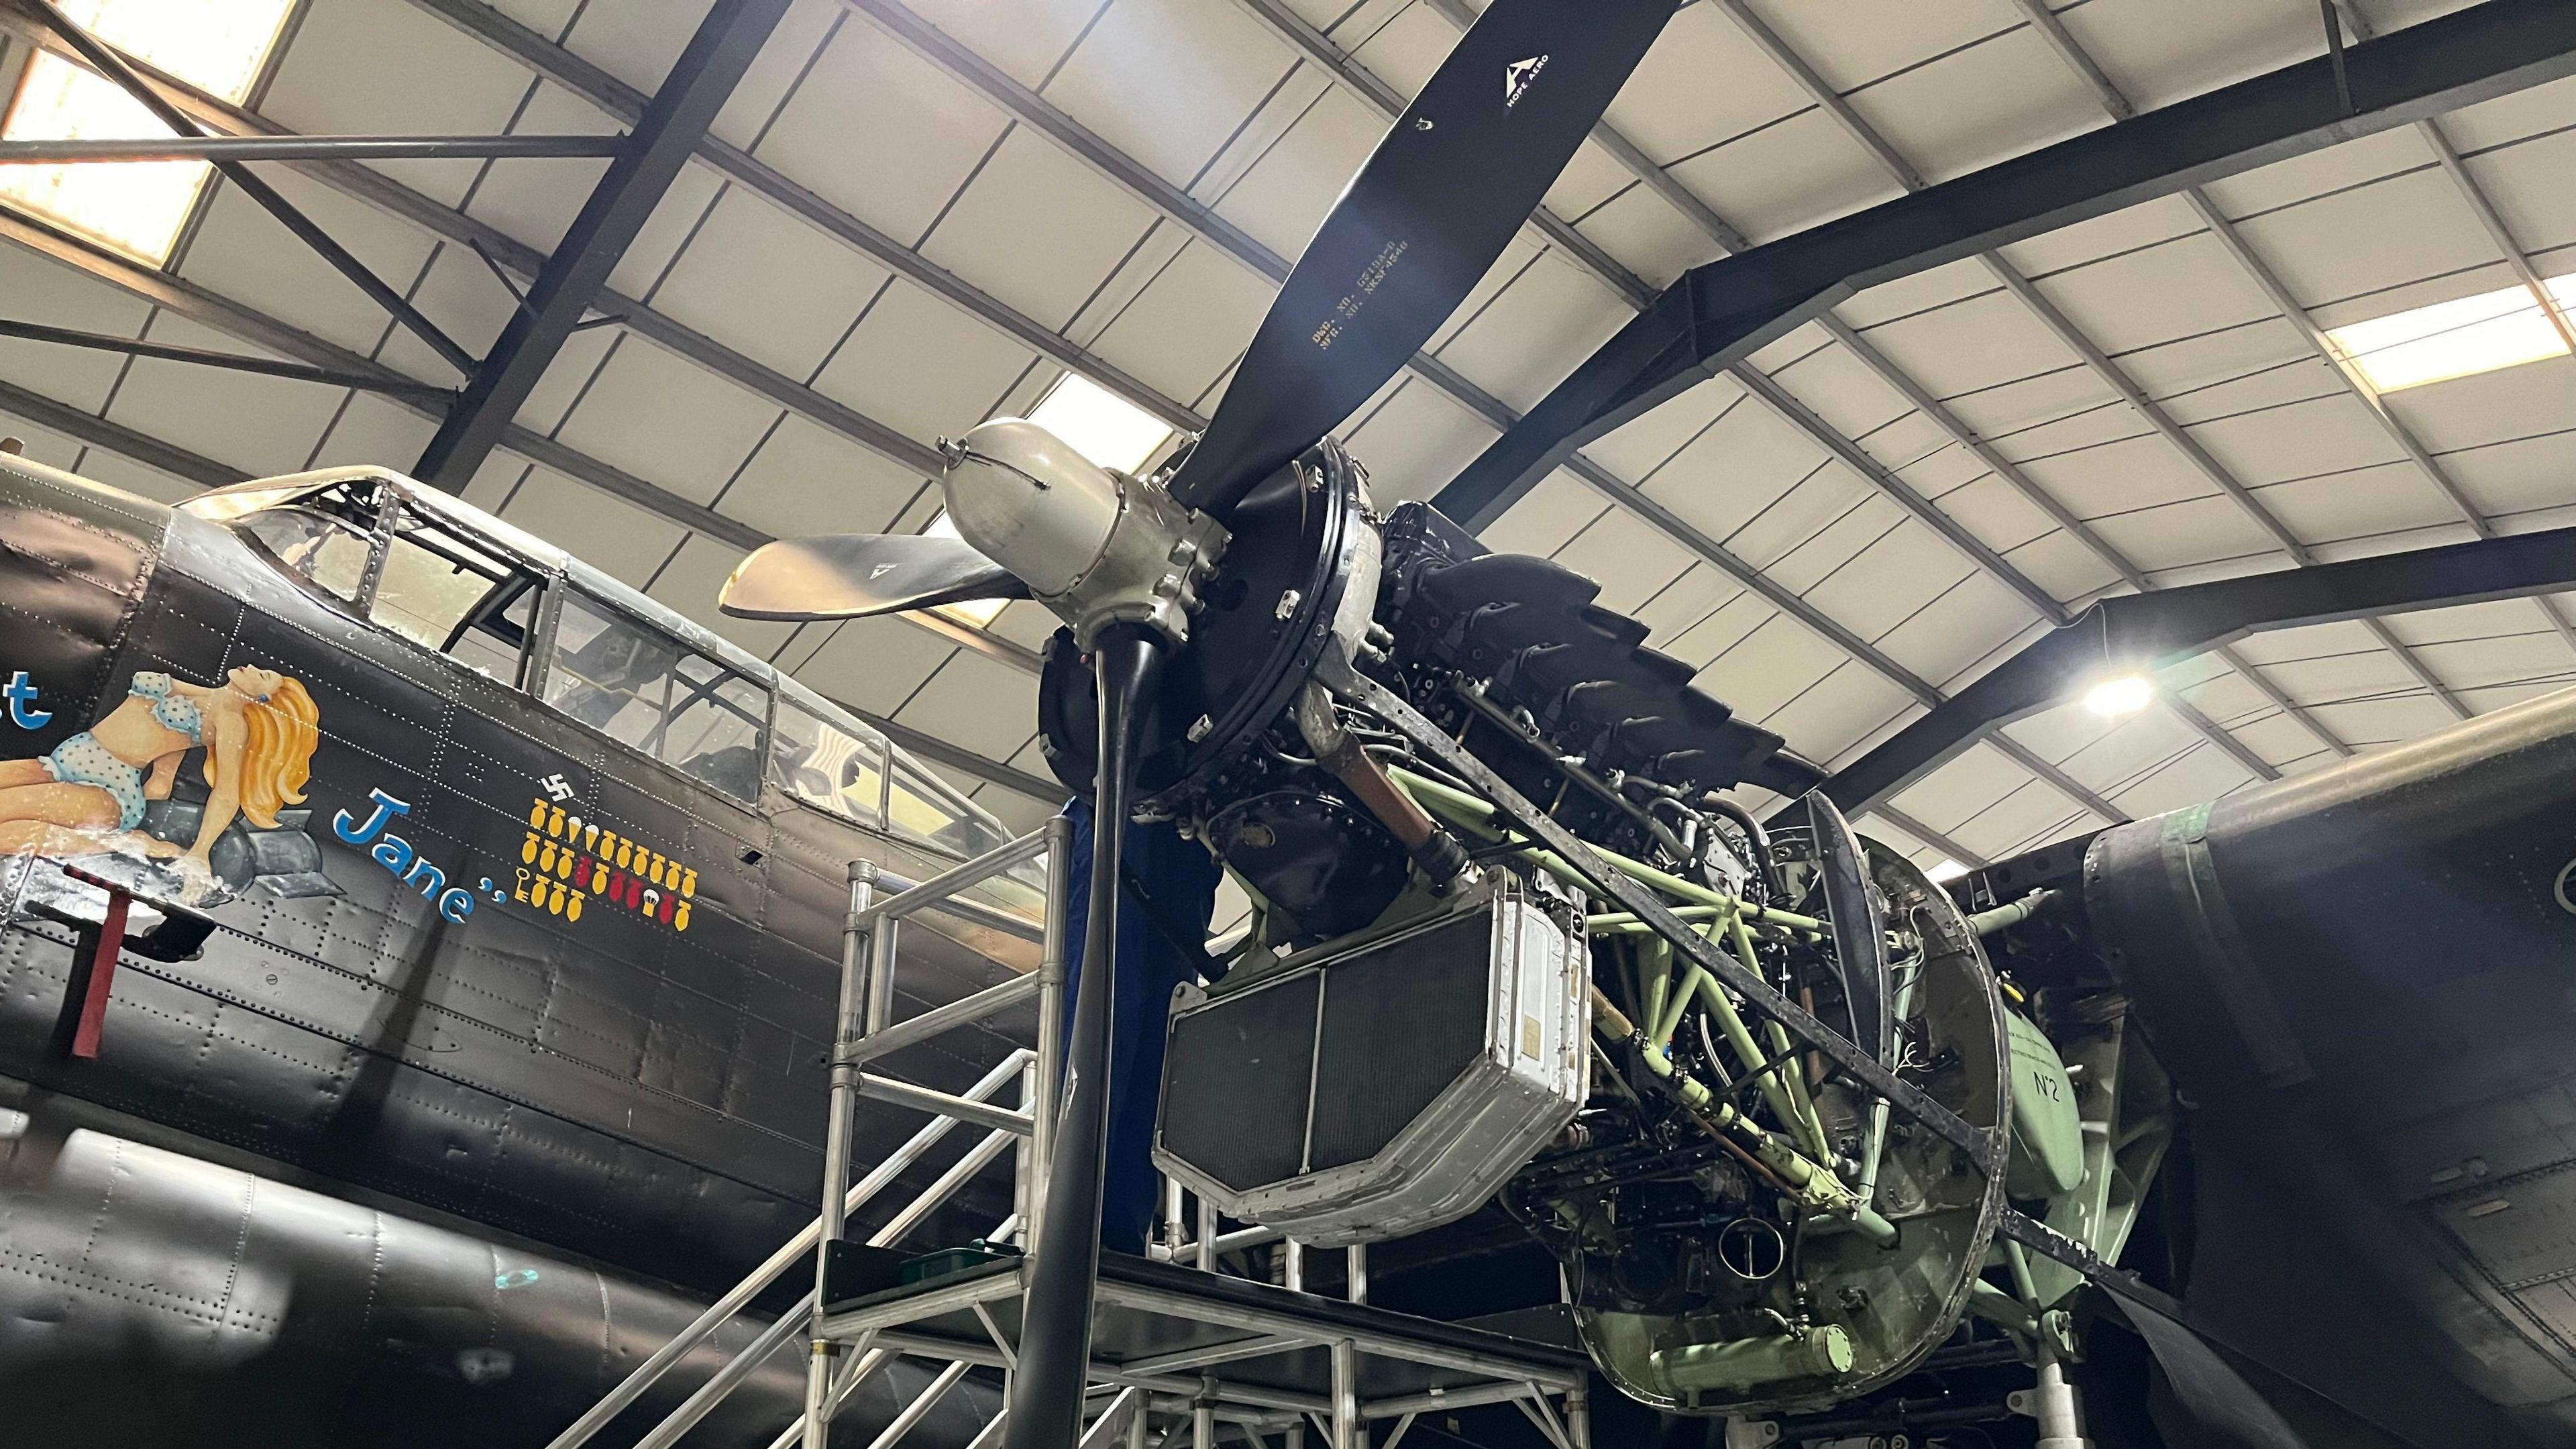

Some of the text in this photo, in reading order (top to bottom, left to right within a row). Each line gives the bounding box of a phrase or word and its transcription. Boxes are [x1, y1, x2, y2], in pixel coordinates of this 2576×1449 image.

[1507, 54, 1548, 107] HOPE AERO
[0, 671, 53, 730] t
